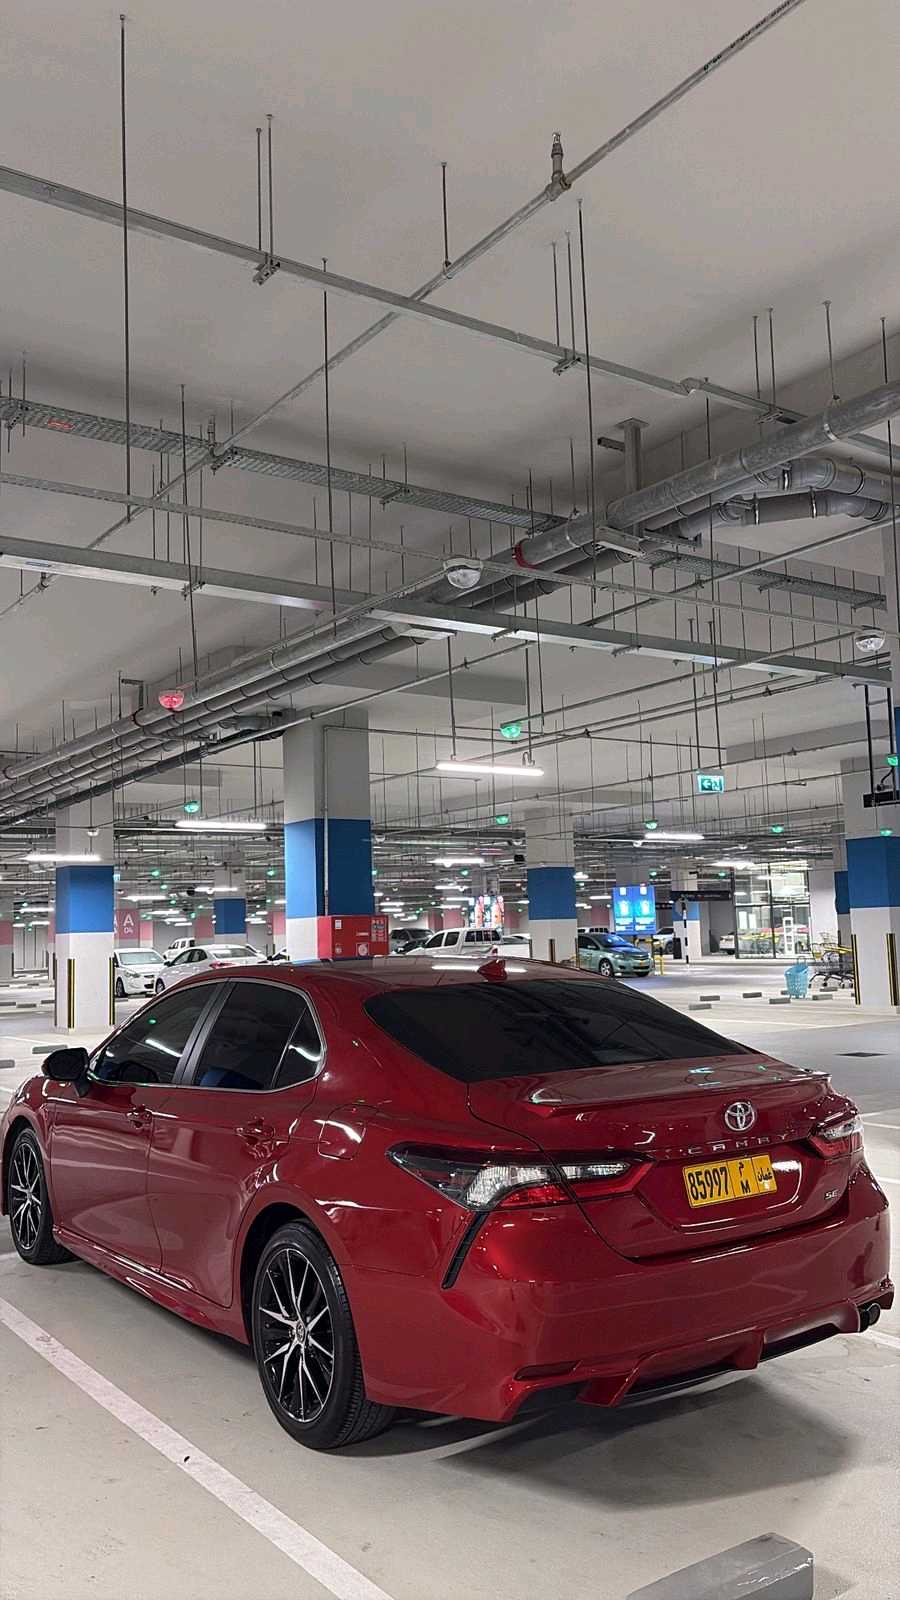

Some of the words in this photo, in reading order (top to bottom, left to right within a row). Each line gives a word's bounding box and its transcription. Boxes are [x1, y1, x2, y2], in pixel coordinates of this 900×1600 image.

[123, 913, 134, 927] A
[688, 1133, 789, 1154] CAMRY
[687, 1166, 729, 1201] 85997
[741, 1180, 751, 1194] M
[825, 1189, 839, 1199] SE
